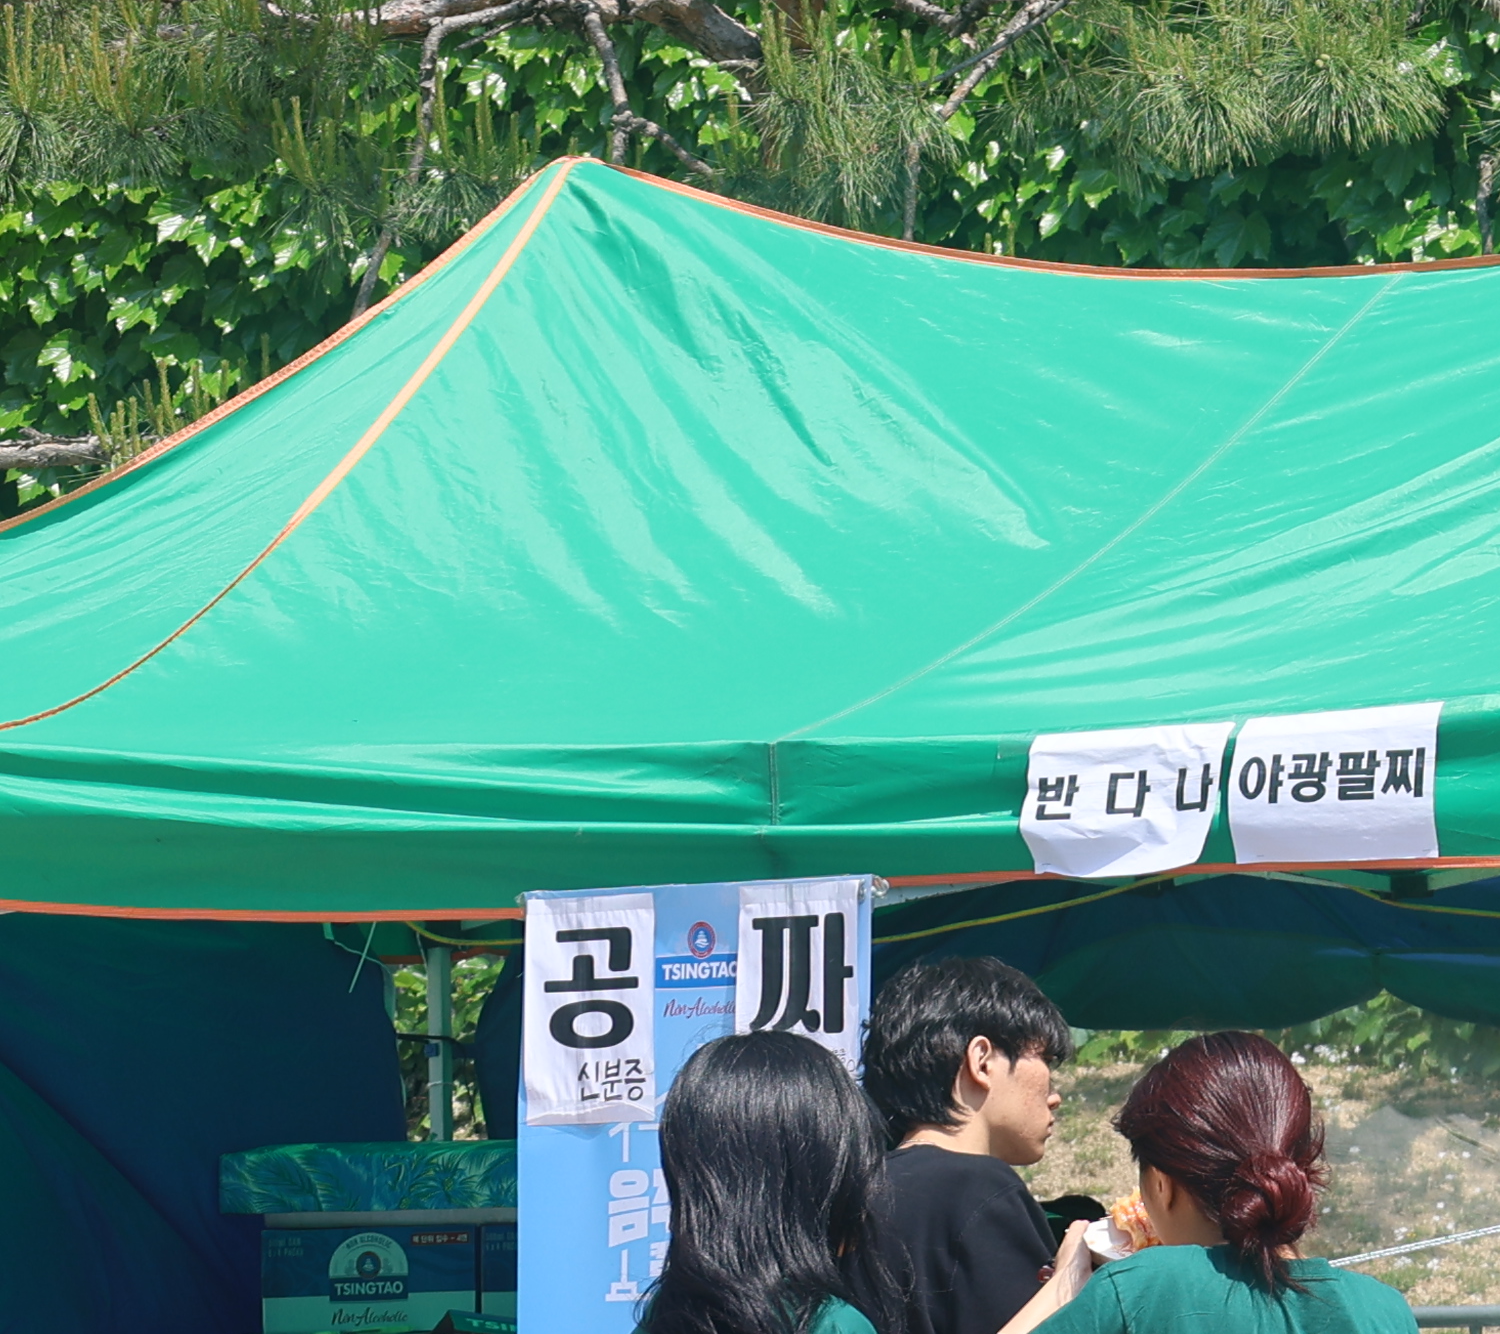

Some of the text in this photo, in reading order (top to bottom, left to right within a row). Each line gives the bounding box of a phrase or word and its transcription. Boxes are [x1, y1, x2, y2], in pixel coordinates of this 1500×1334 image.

[1237, 747, 1427, 804] 야광팔찌
[577, 1057, 648, 1102] 신분증
[334, 1280, 404, 1296] TSINGTAO
